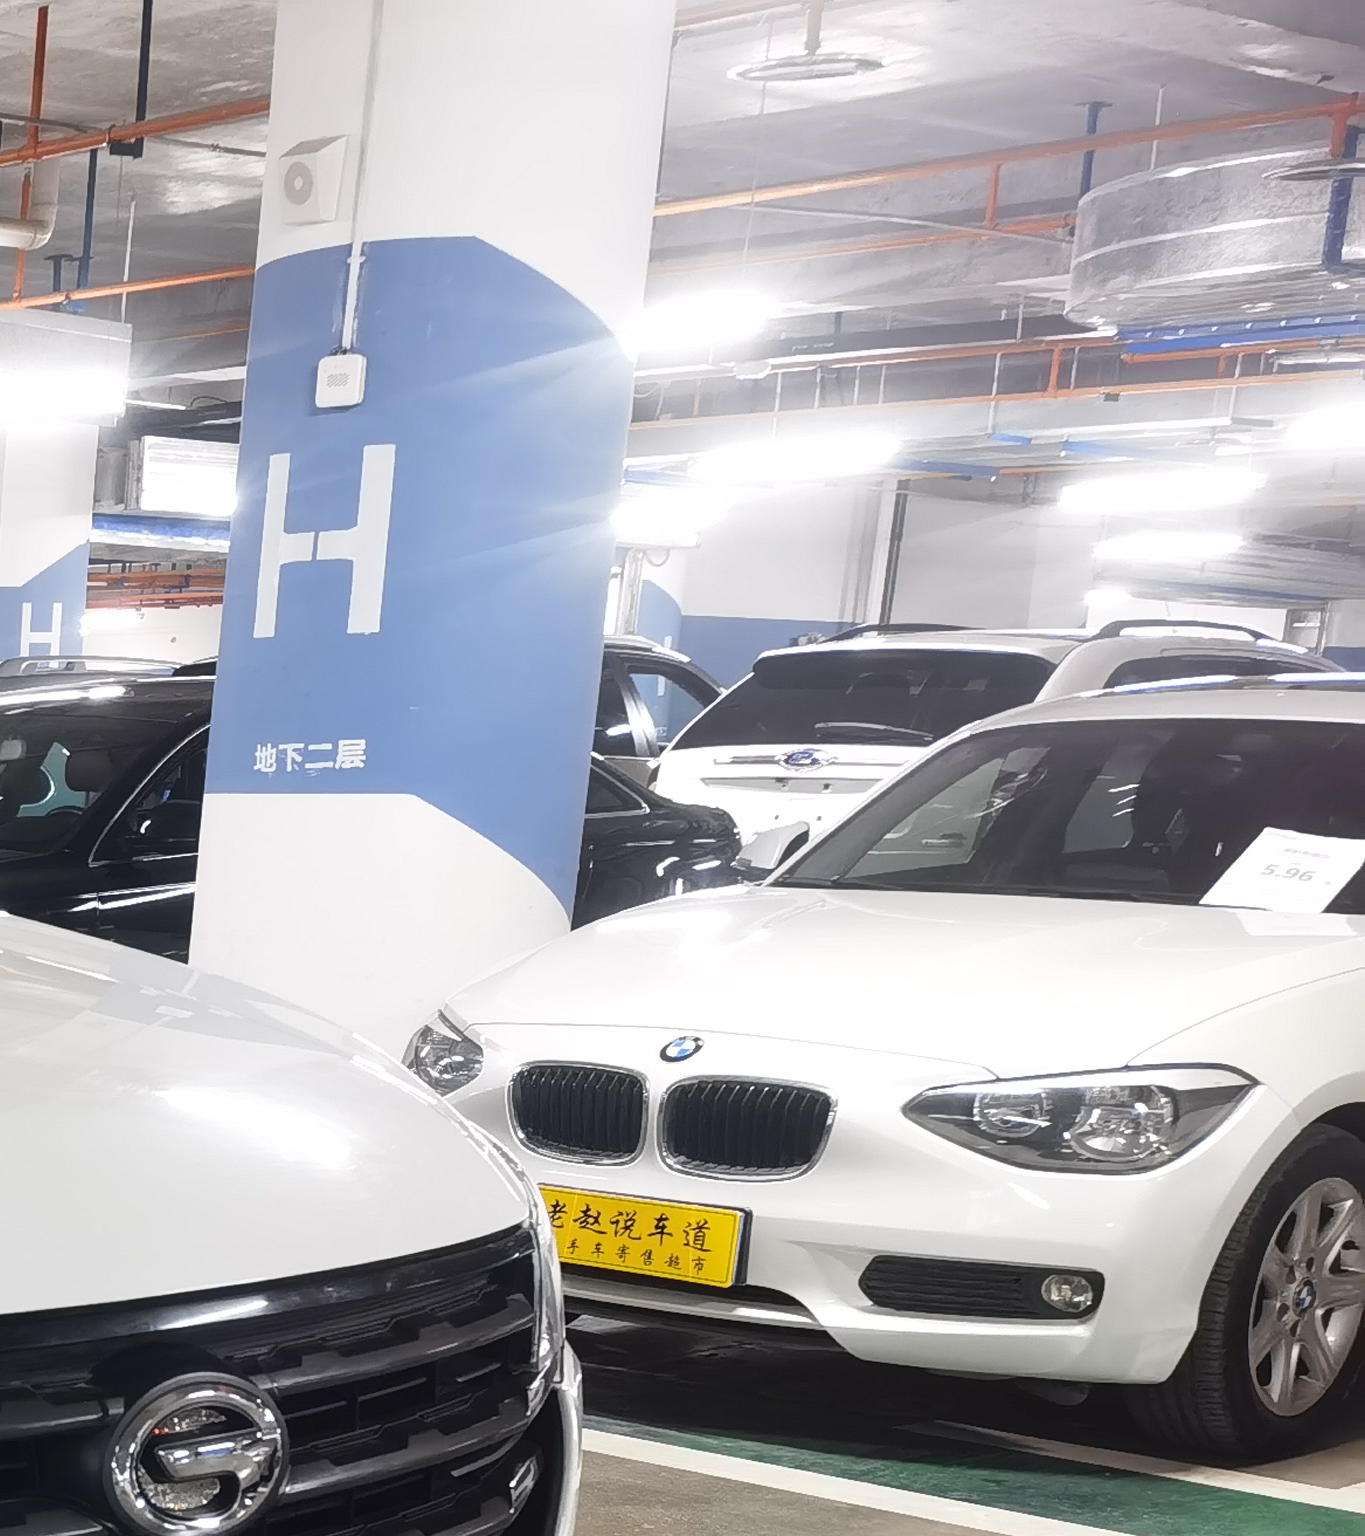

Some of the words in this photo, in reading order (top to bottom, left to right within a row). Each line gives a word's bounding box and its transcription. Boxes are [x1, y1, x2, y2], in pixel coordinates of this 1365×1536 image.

[253, 444, 396, 638] H
[20, 602, 63, 657] H
[253, 739, 367, 772] 地下二层
[1260, 864, 1316, 882] 5.96
[548, 1199, 713, 1253] 老赵说车道
